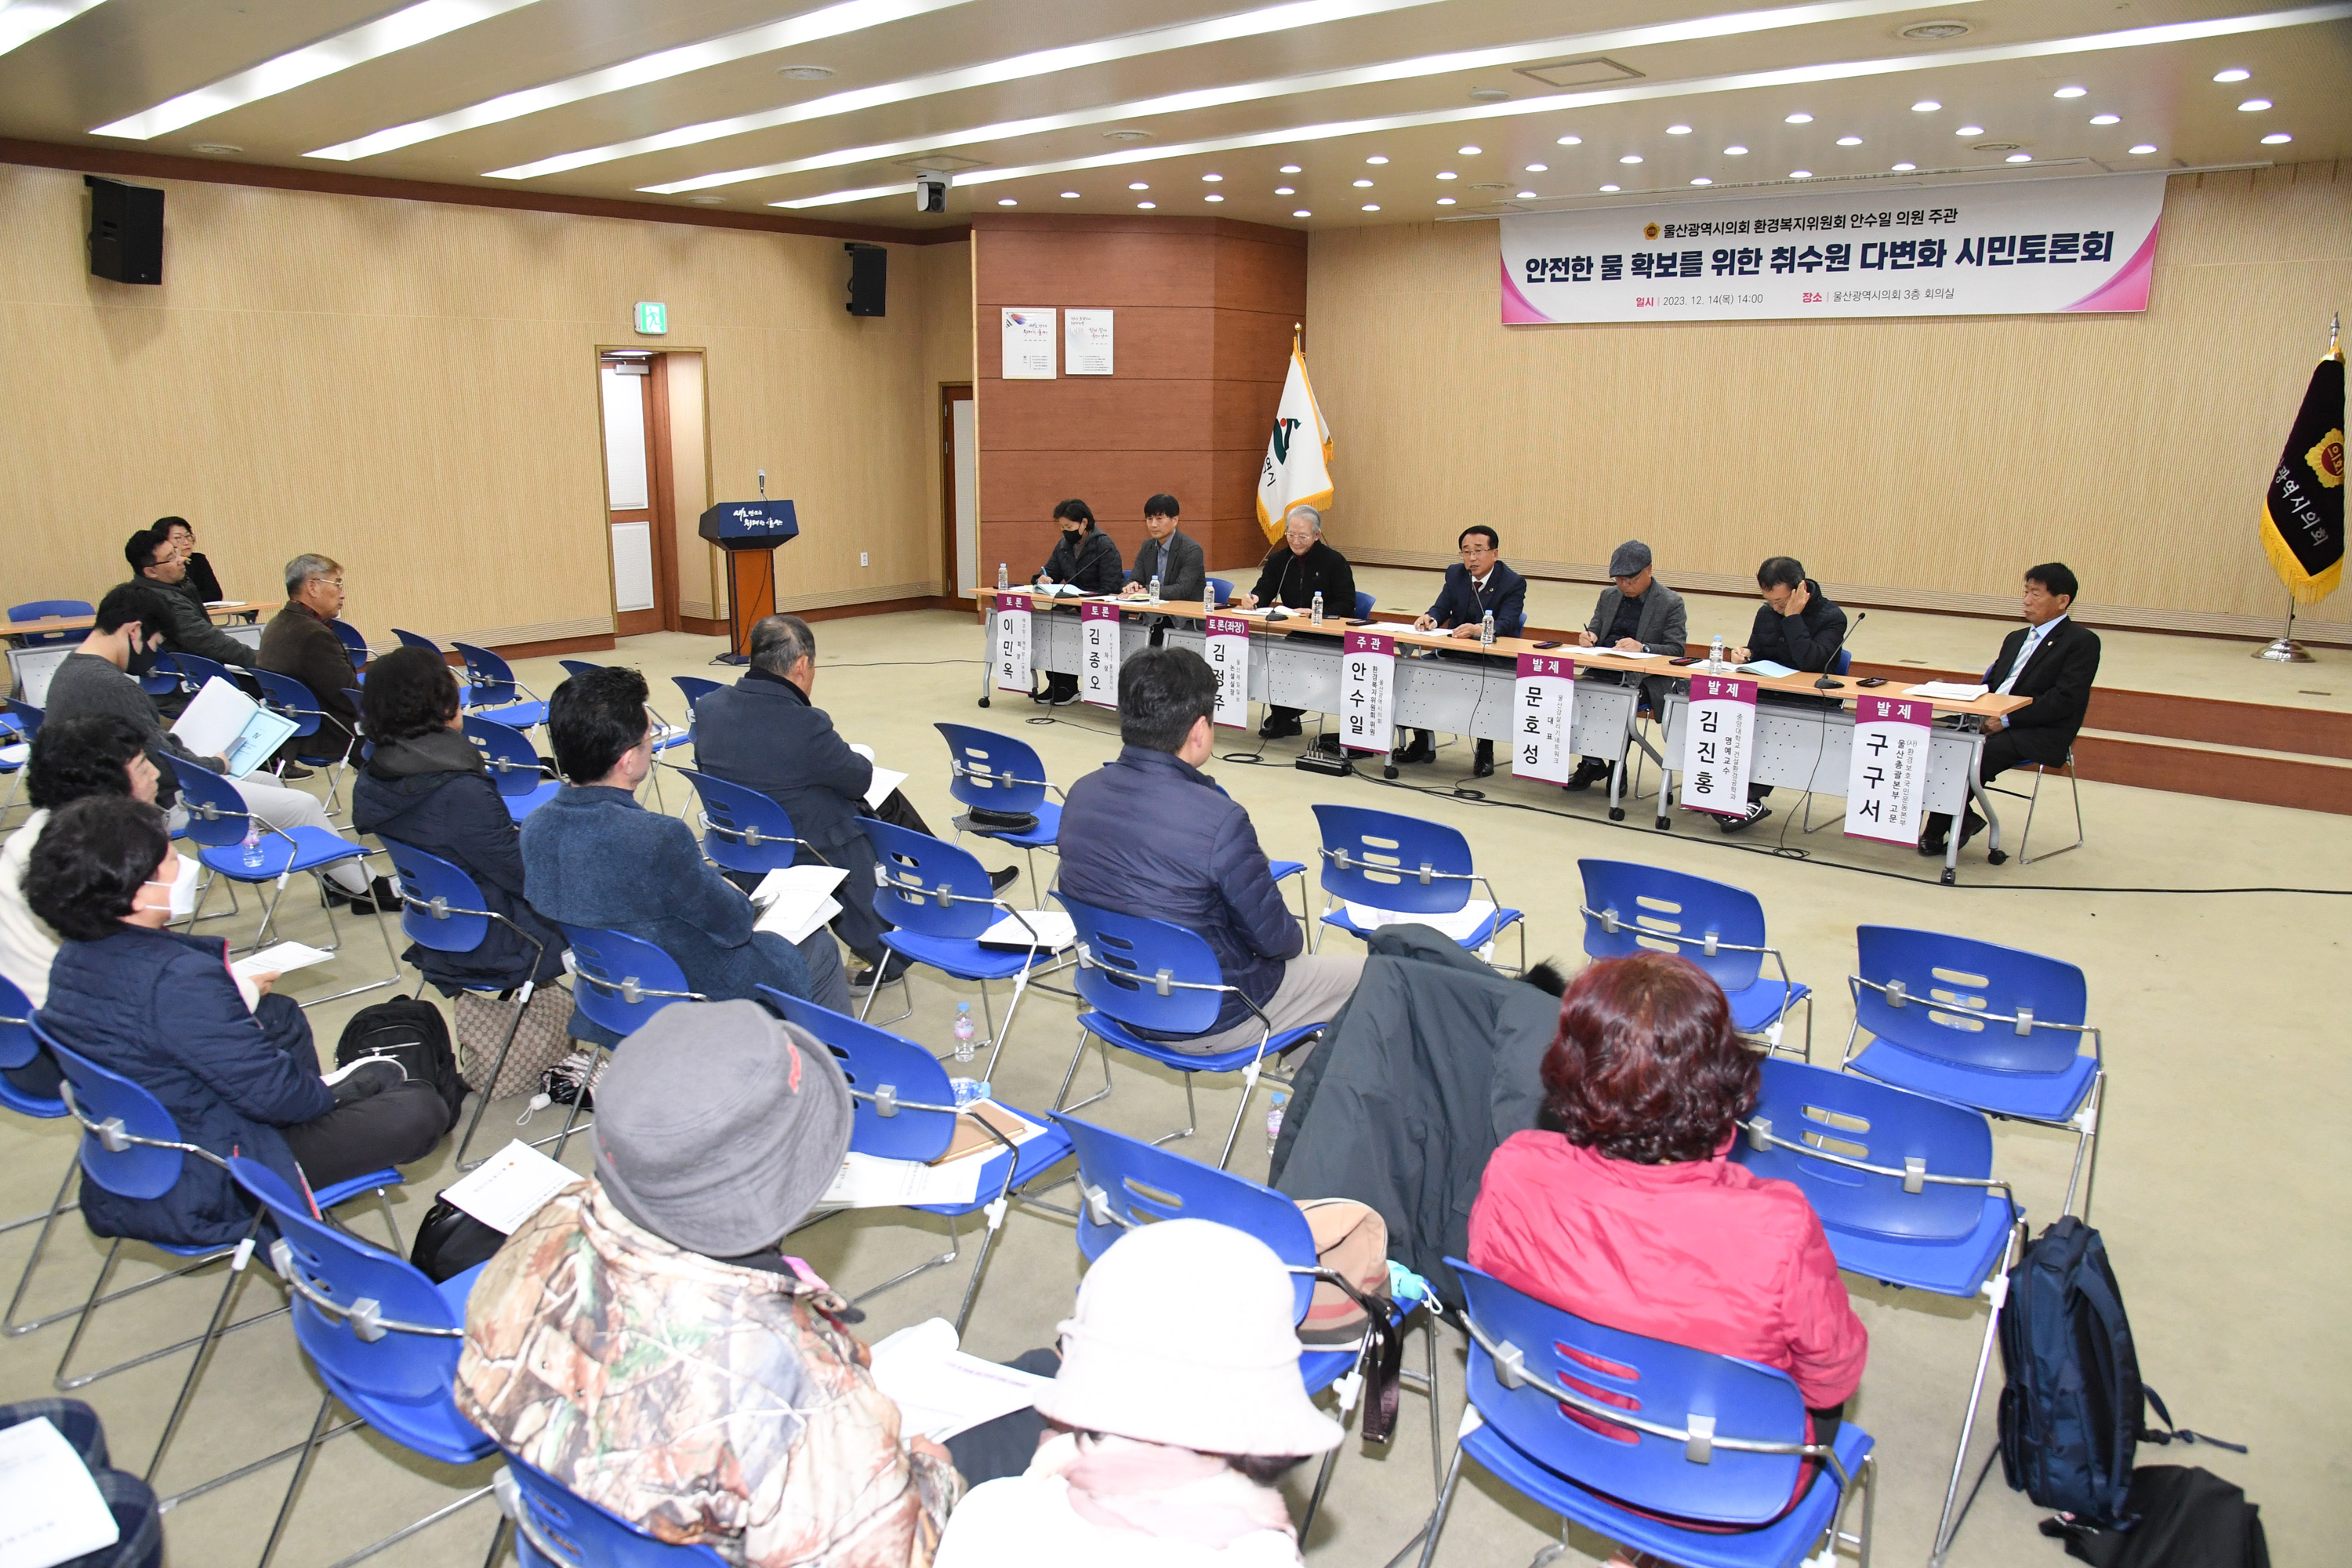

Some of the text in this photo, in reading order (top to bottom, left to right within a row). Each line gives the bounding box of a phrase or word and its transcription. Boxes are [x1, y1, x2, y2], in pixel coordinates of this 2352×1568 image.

[1664, 208, 1958, 238] 울산광역시의회 환경복지위원회 안수일 의원 주관
[1526, 230, 2114, 283] 안전한 물 확보를 위한 취수원 다변화 시민토론회
[1635, 293, 1763, 307] 일시 2023. 12. 14(목) 14:00
[1802, 287, 1955, 303] 장소 울산광역시의회 3층 회의실
[2275, 458, 2328, 546] 광역시의회
[1003, 618, 1014, 680] 이민옥
[1089, 628, 1101, 691] 김종오
[1356, 636, 1381, 651] 주관
[1532, 658, 1559, 674] 발제
[1349, 662, 1367, 735] 안수일
[1708, 680, 1739, 698] 발제
[1876, 700, 1911, 720] 발제
[1523, 686, 1543, 765] 문호성
[1553, 694, 1563, 764] 울산강살리기네트워크
[1694, 710, 1719, 794] 김진홍
[1722, 736, 1733, 775] 명예교수
[1730, 713, 1743, 801] 중앙대학교 건설환경공학과
[1859, 733, 1889, 823] 구구서
[1889, 739, 1906, 824] 울산총괄본부 고문
